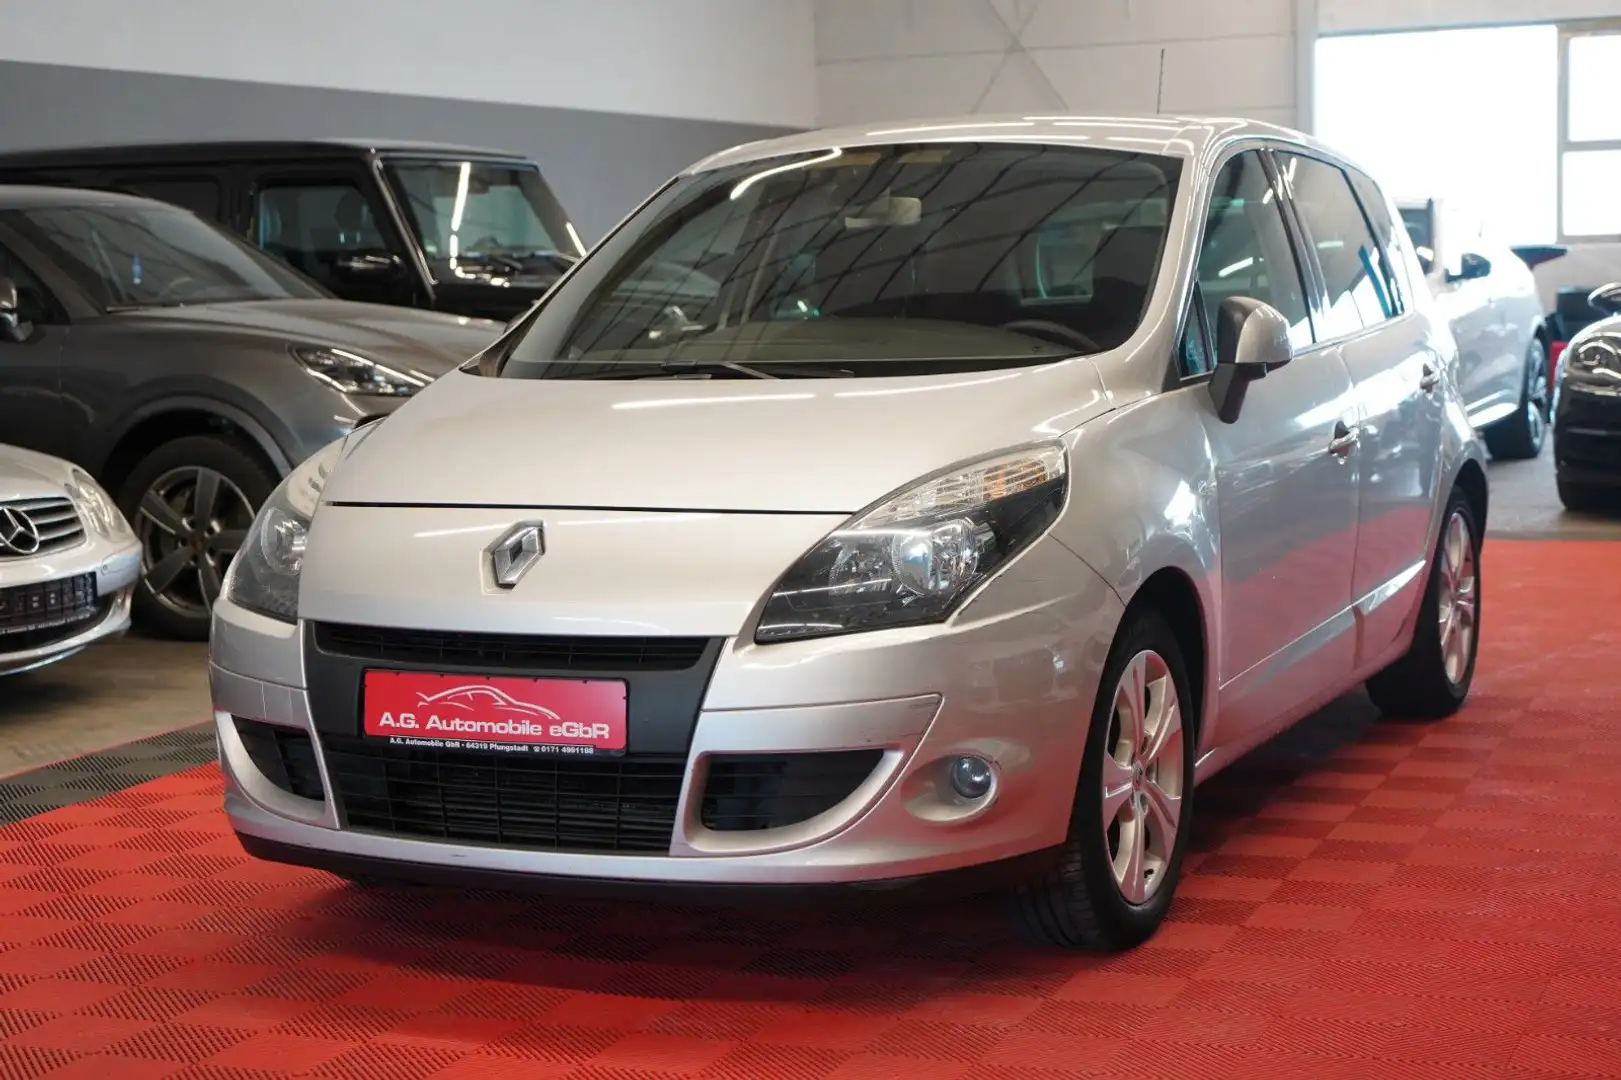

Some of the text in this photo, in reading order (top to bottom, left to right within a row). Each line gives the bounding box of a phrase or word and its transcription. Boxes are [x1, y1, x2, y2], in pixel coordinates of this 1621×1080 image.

[379, 712, 609, 739] A.G. Automobile eGbR
[389, 737, 404, 745] A.G.
[405, 738, 444, 747] Automobile
[489, 743, 528, 752] Pfungstadt
[541, 745, 559, 753] 0171
